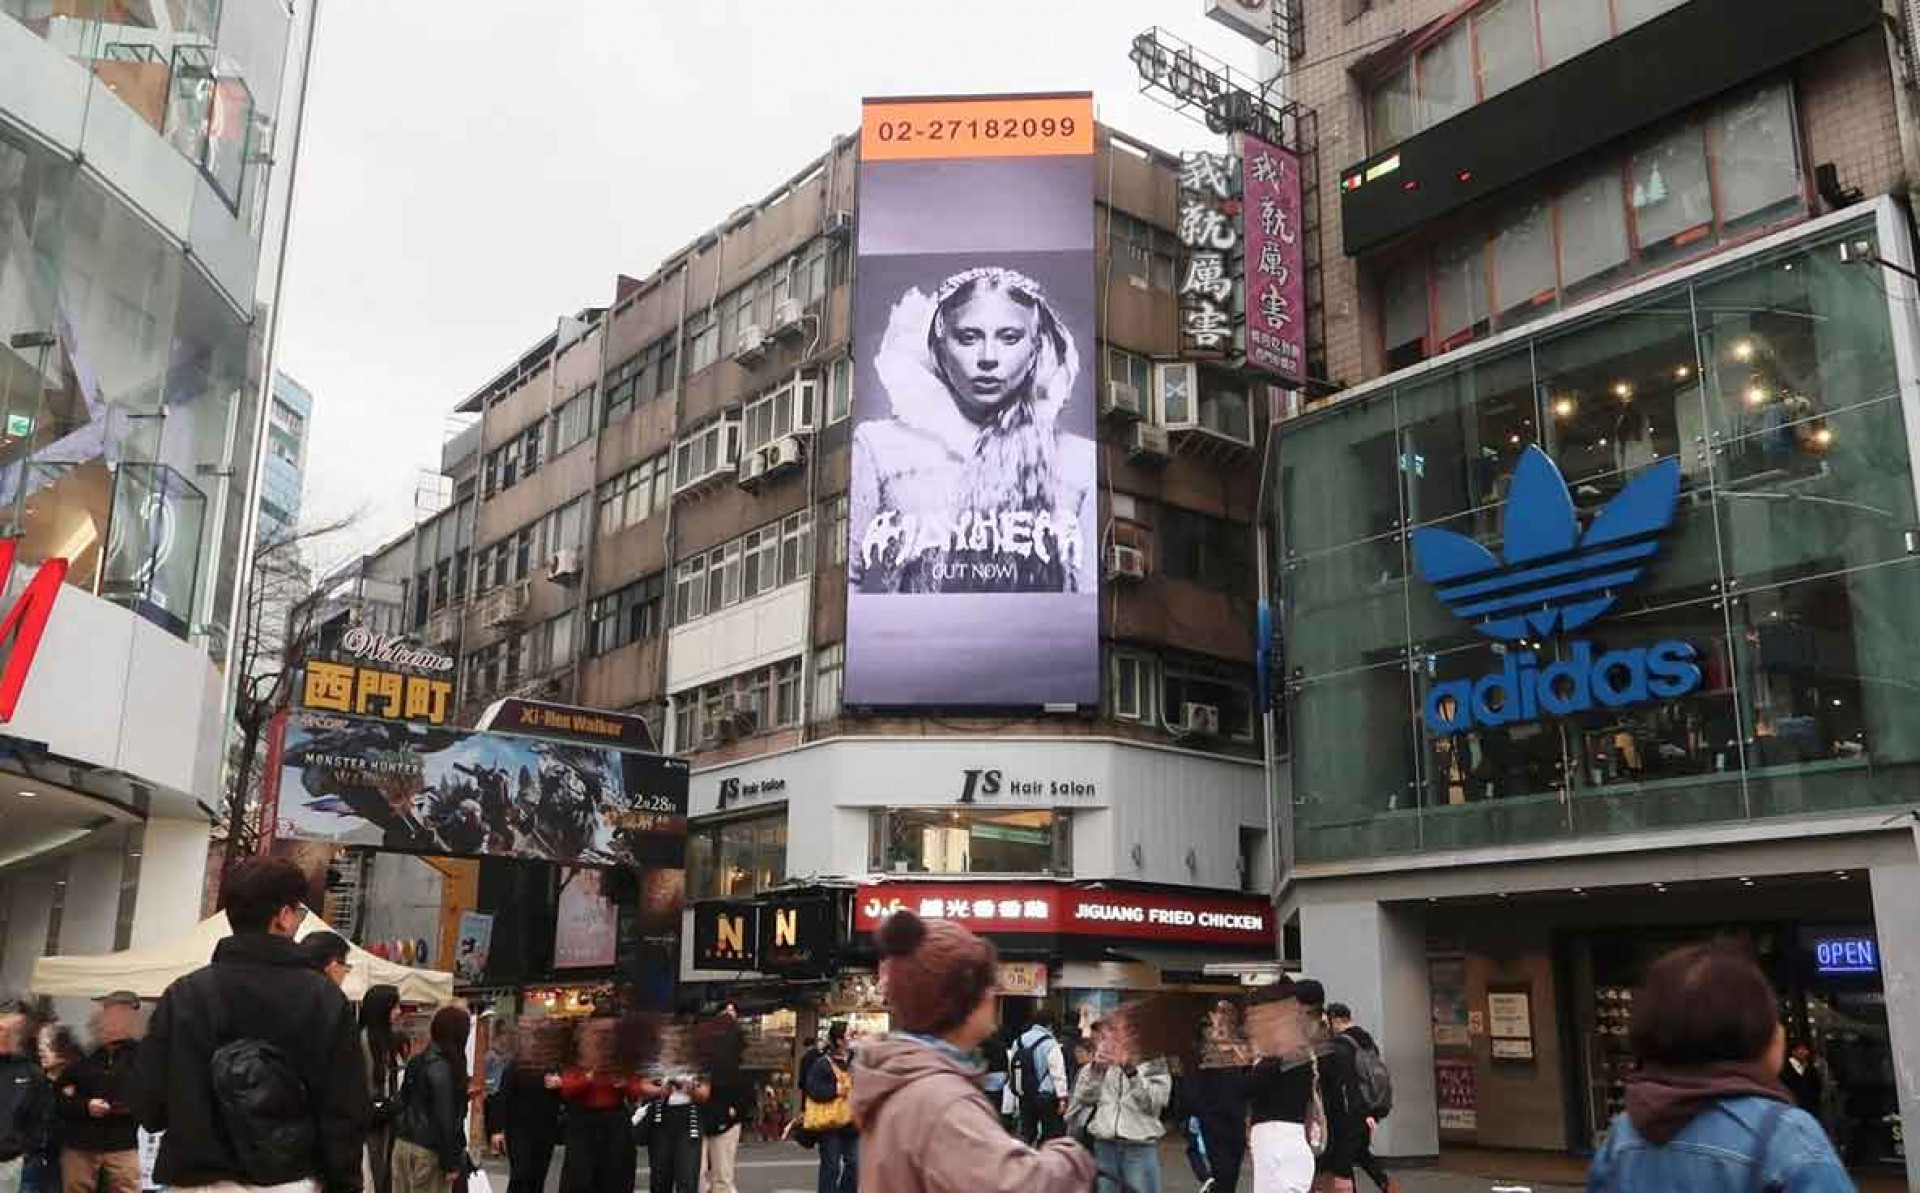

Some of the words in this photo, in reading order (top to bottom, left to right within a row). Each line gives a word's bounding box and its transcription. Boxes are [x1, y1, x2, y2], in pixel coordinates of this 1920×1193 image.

[878, 116, 1076, 142] 02-27182099
[931, 564, 968, 579] OUT
[972, 563, 1016, 579] NOW
[343, 629, 453, 671] Welcome
[304, 660, 453, 724] 西門町
[1425, 640, 1702, 736] adidas
[305, 753, 365, 769] MONSTER
[1010, 780, 1041, 796] Hair
[1050, 780, 1096, 796] Salon
[775, 908, 797, 948] N
[1075, 903, 1145, 922] JIGUANG
[1149, 908, 1195, 925] FRIED
[1198, 912, 1264, 930] CHICKEN
[1817, 940, 1873, 966] OPEN
